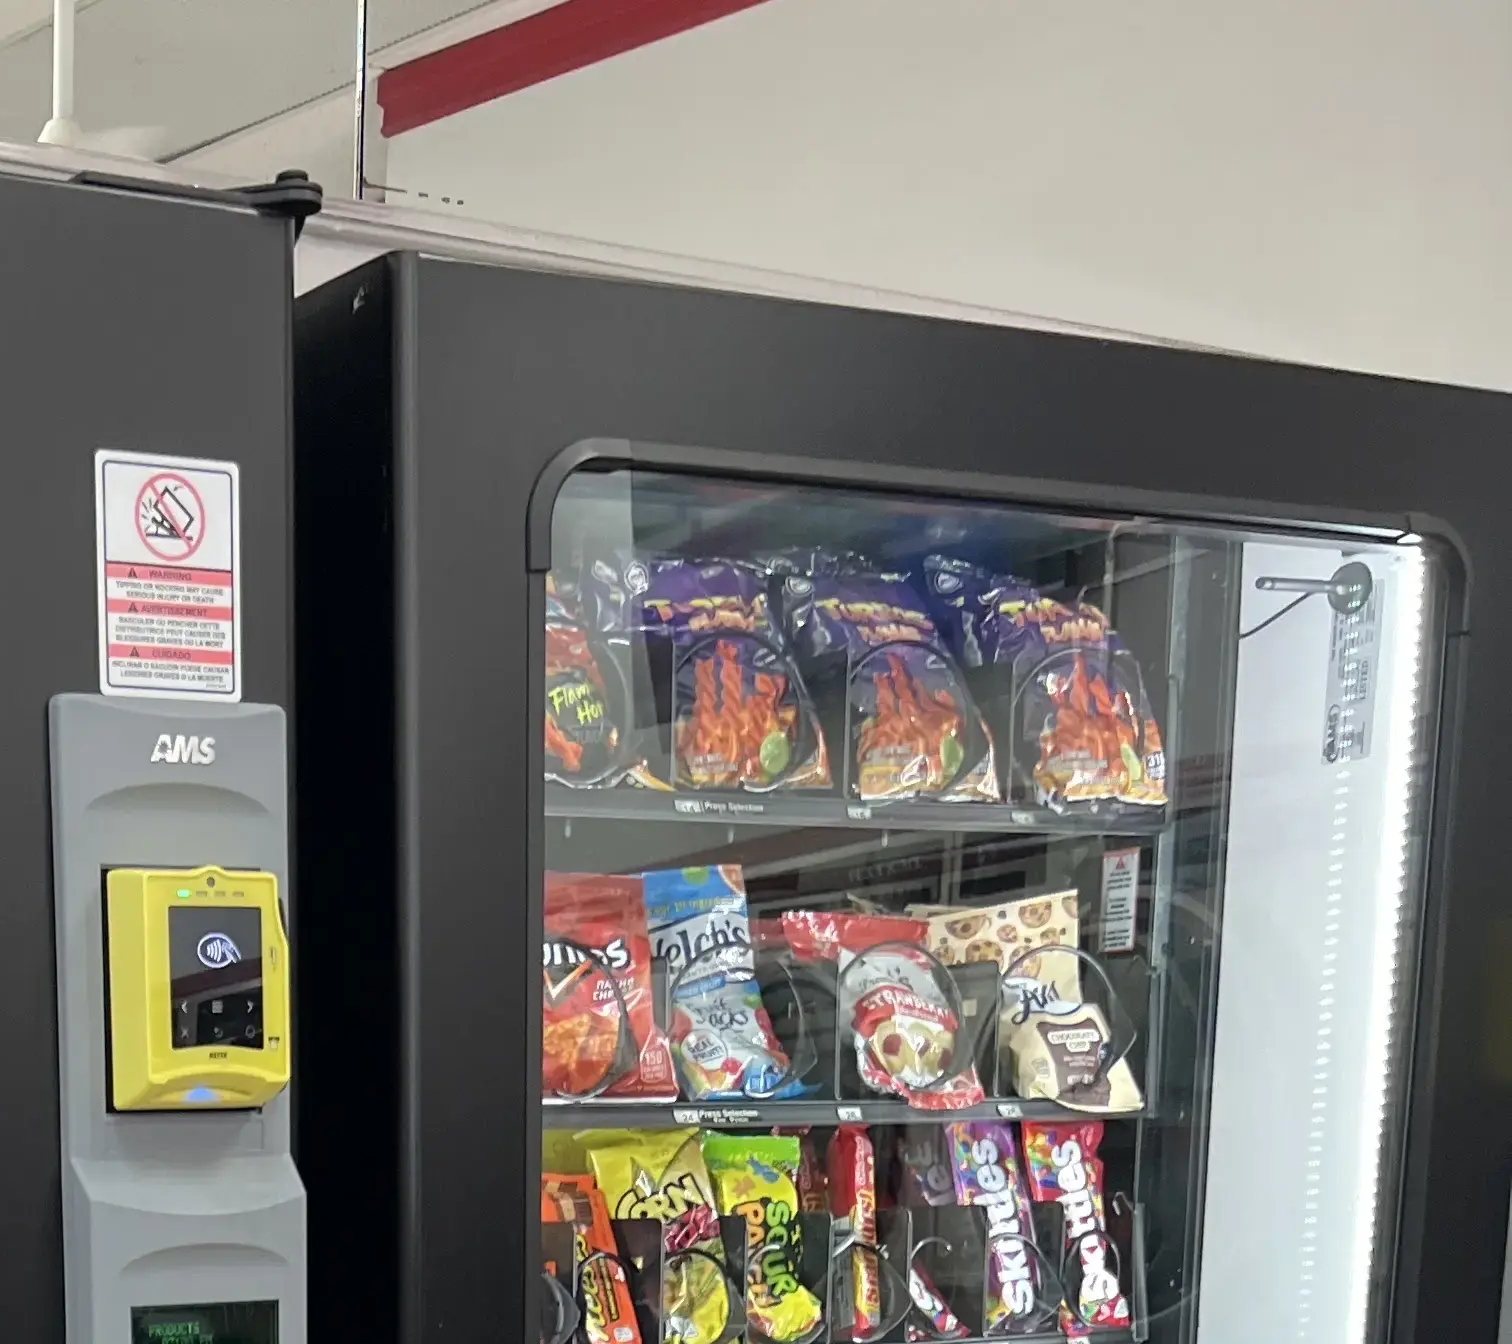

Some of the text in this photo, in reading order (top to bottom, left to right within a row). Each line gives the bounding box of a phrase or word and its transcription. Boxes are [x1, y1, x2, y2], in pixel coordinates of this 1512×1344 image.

[149, 570, 192, 581] WARNING
[126, 591, 155, 599] SERIOUS
[201, 588, 224, 596] CAUSE
[152, 648, 191, 660] CUIDADO
[151, 734, 215, 765] AMS
[645, 1052, 662, 1066] 150
[699, 1109, 721, 1117] Press
[723, 1108, 758, 1117] Selection
[763, 1200, 798, 1296] SOUR
[149, 1322, 200, 1337] PRODUCTS
